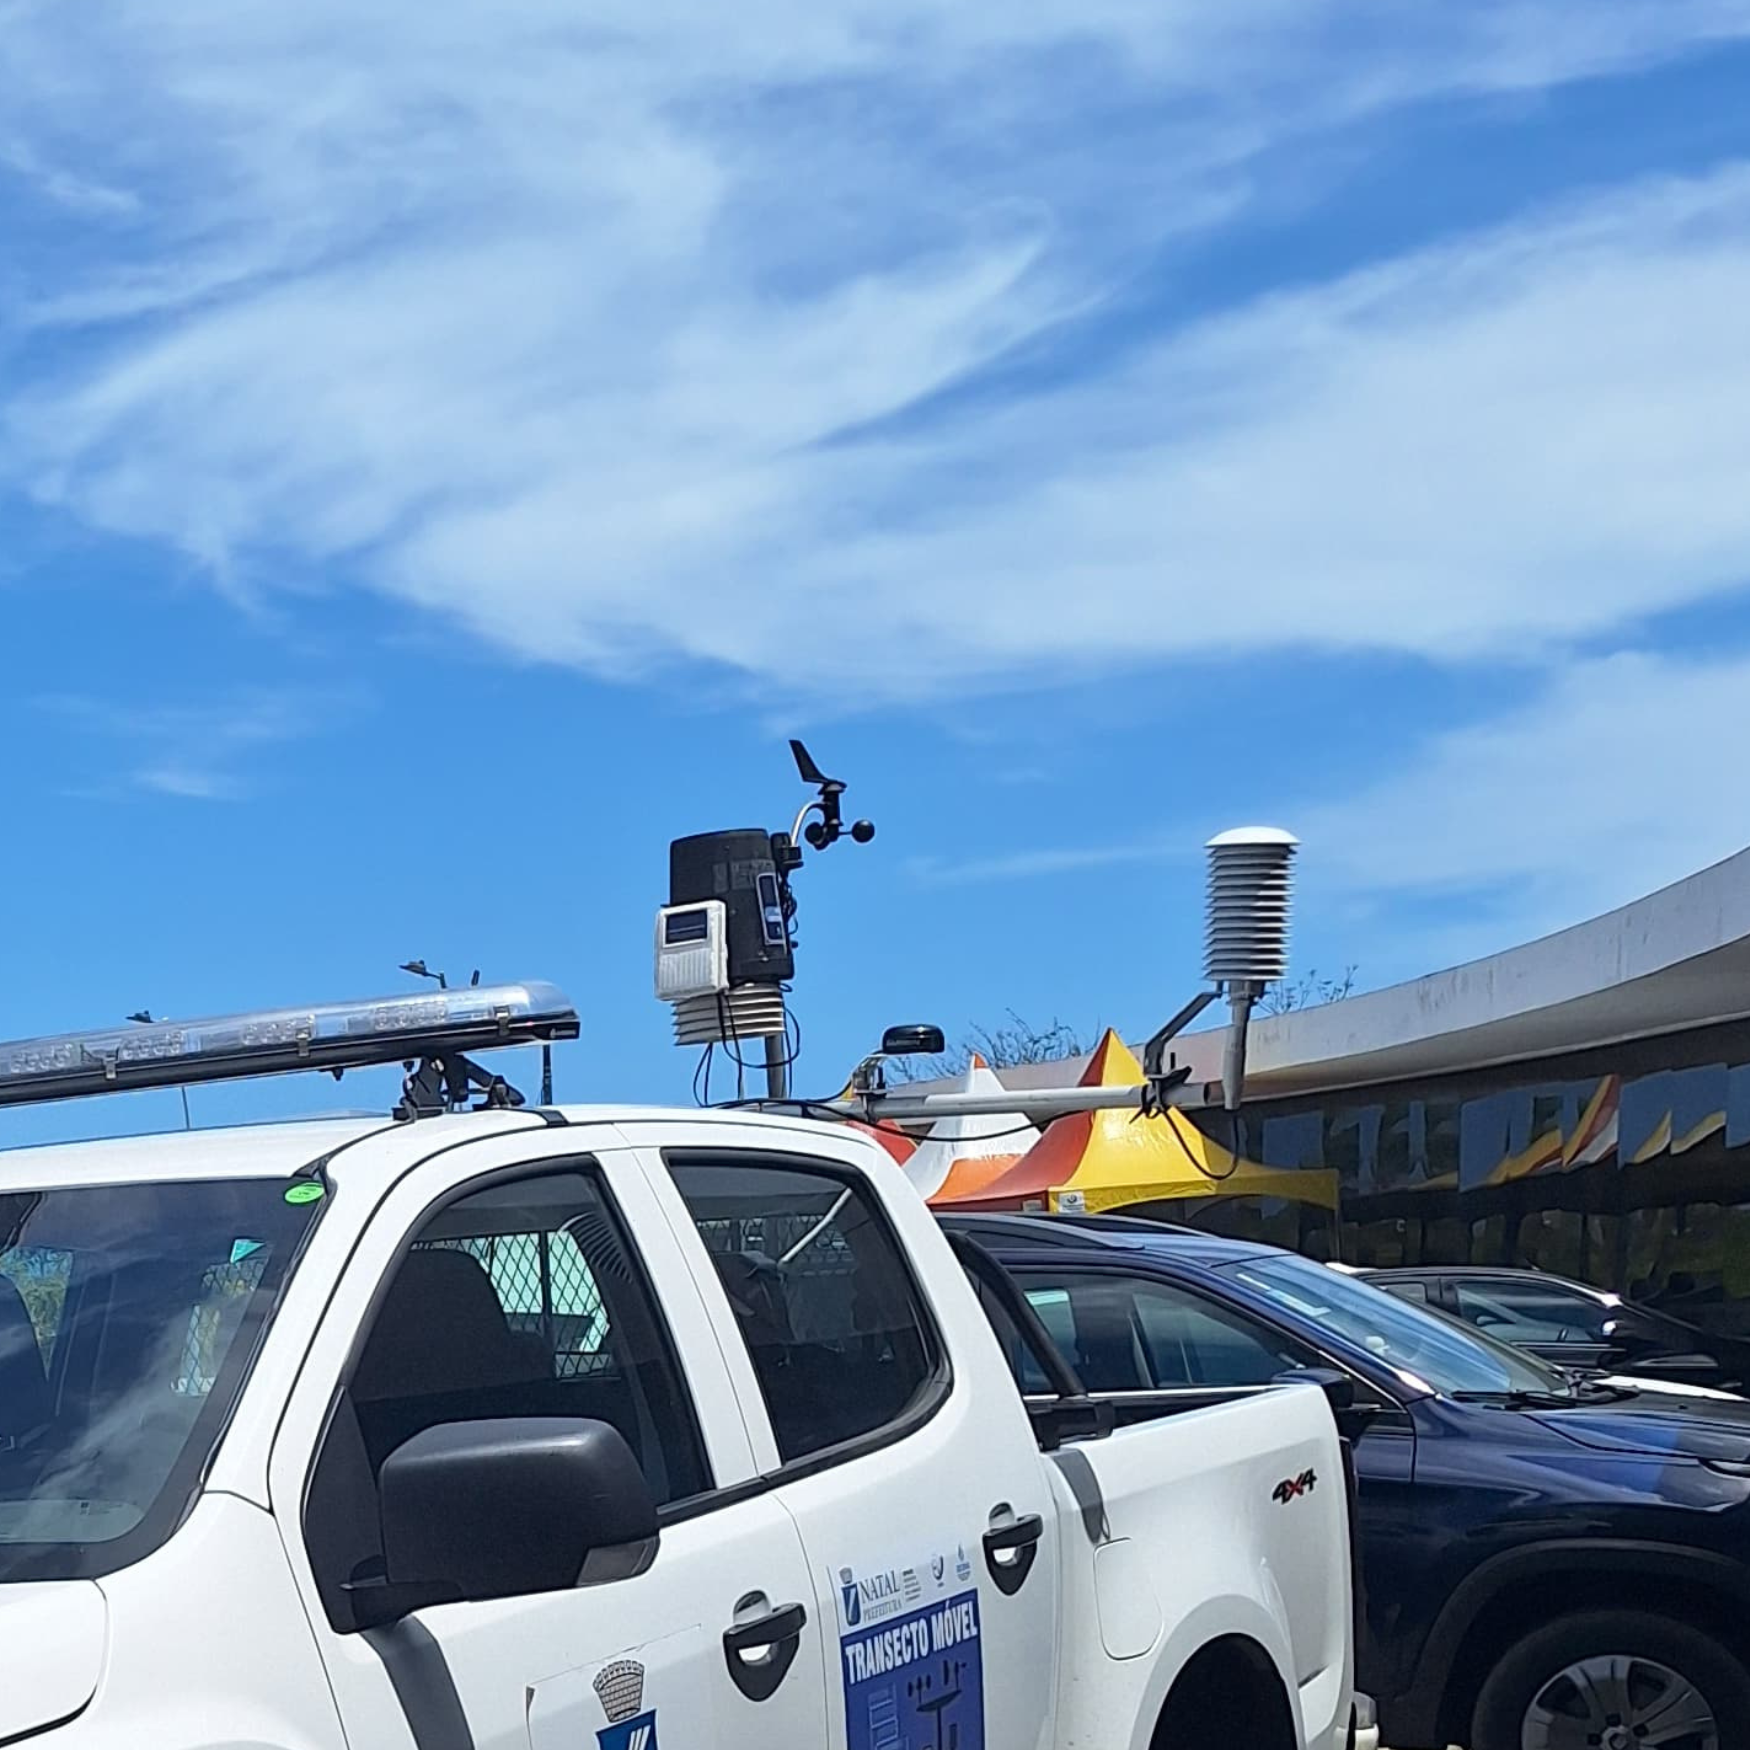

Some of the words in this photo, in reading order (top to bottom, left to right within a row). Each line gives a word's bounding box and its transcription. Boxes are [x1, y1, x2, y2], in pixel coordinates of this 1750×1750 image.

[858, 1569, 901, 1604] NATAL
[845, 1617, 930, 1686] TRANSECTO
[930, 1598, 979, 1653] MÓVEL
